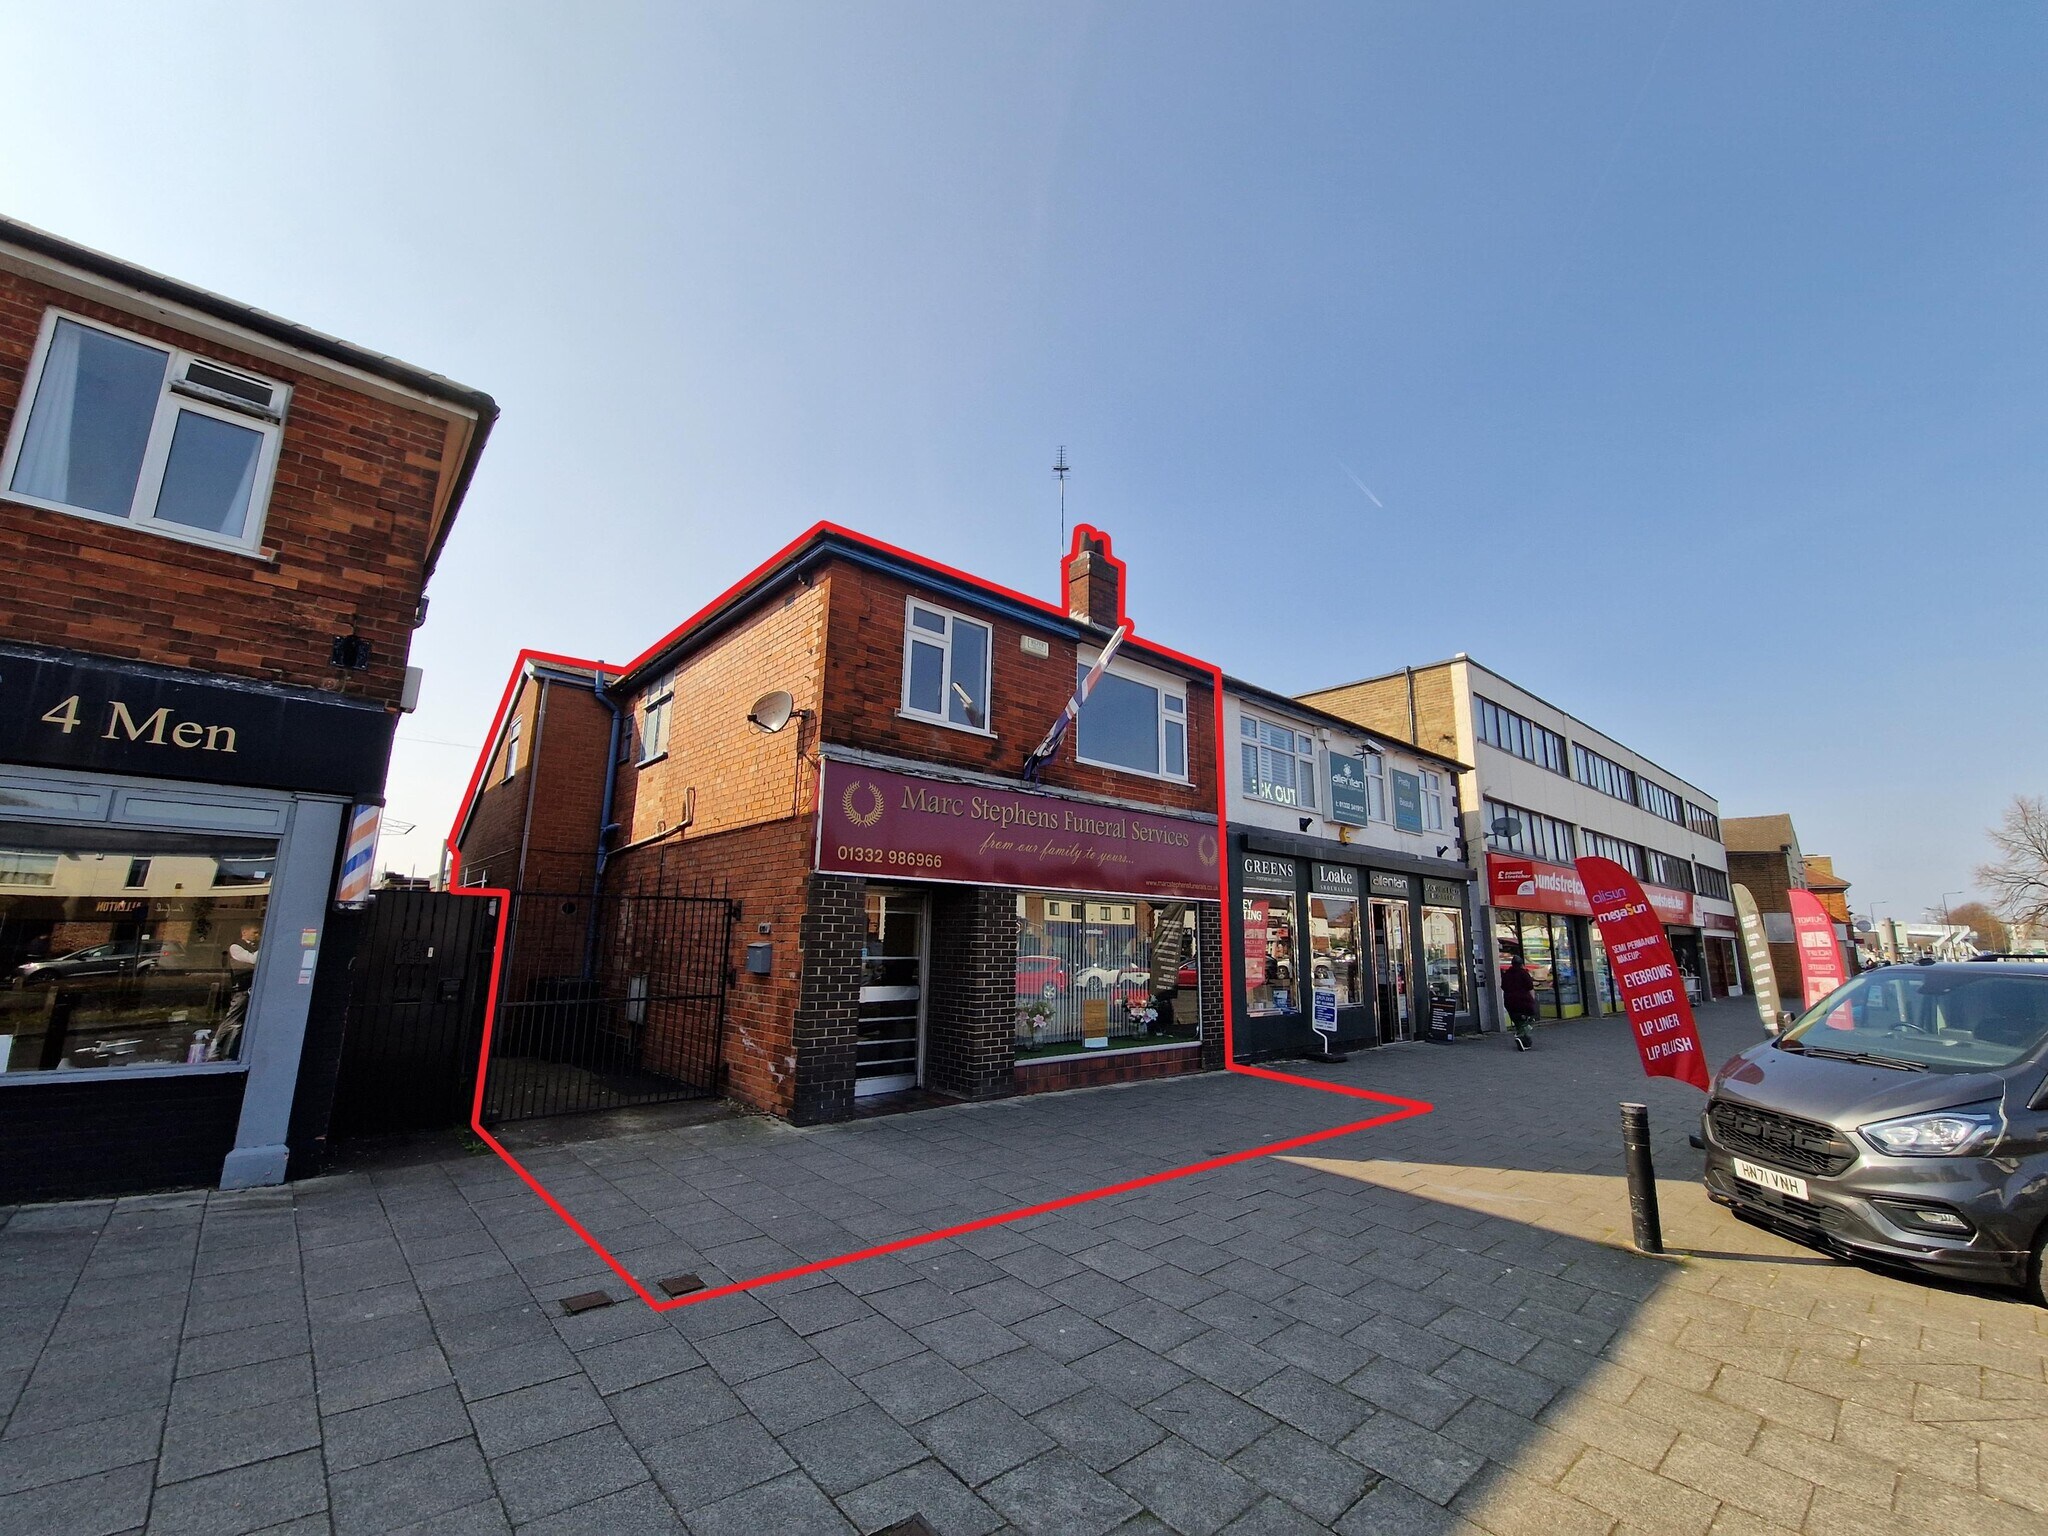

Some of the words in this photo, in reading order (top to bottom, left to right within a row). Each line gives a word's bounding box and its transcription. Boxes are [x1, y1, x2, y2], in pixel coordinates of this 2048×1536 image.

[41, 695, 81, 734] 4
[101, 700, 238, 753] Men
[1275, 785, 1297, 806] OUT
[901, 786, 965, 816] Marc
[970, 796, 1059, 829] Stephens
[1064, 810, 1128, 839] Funeral
[1131, 821, 1190, 847] Services
[837, 845, 884, 863] 01332
[888, 850, 942, 868] 986966
[978, 832, 1014, 855] from
[1016, 844, 1038, 853] our
[1039, 838, 1083, 865] family
[1083, 846, 1096, 859] to
[1244, 858, 1294, 877] GREENS
[1320, 865, 1353, 885] Loake
[1598, 902, 1648, 924] megaSun
[1612, 943, 1628, 954] SEMI
[1623, 963, 1673, 988] EYEBROWS
[1631, 989, 1675, 1012] EYELINER
[1639, 1020, 1653, 1037] LIP
[1654, 1013, 1680, 1032] LINER
[1646, 1045, 1660, 1061] LIP
[1661, 1036, 1693, 1057] BLUSH
[1741, 1162, 1769, 1185] HN71
[1772, 1175, 1799, 1194] VNH
